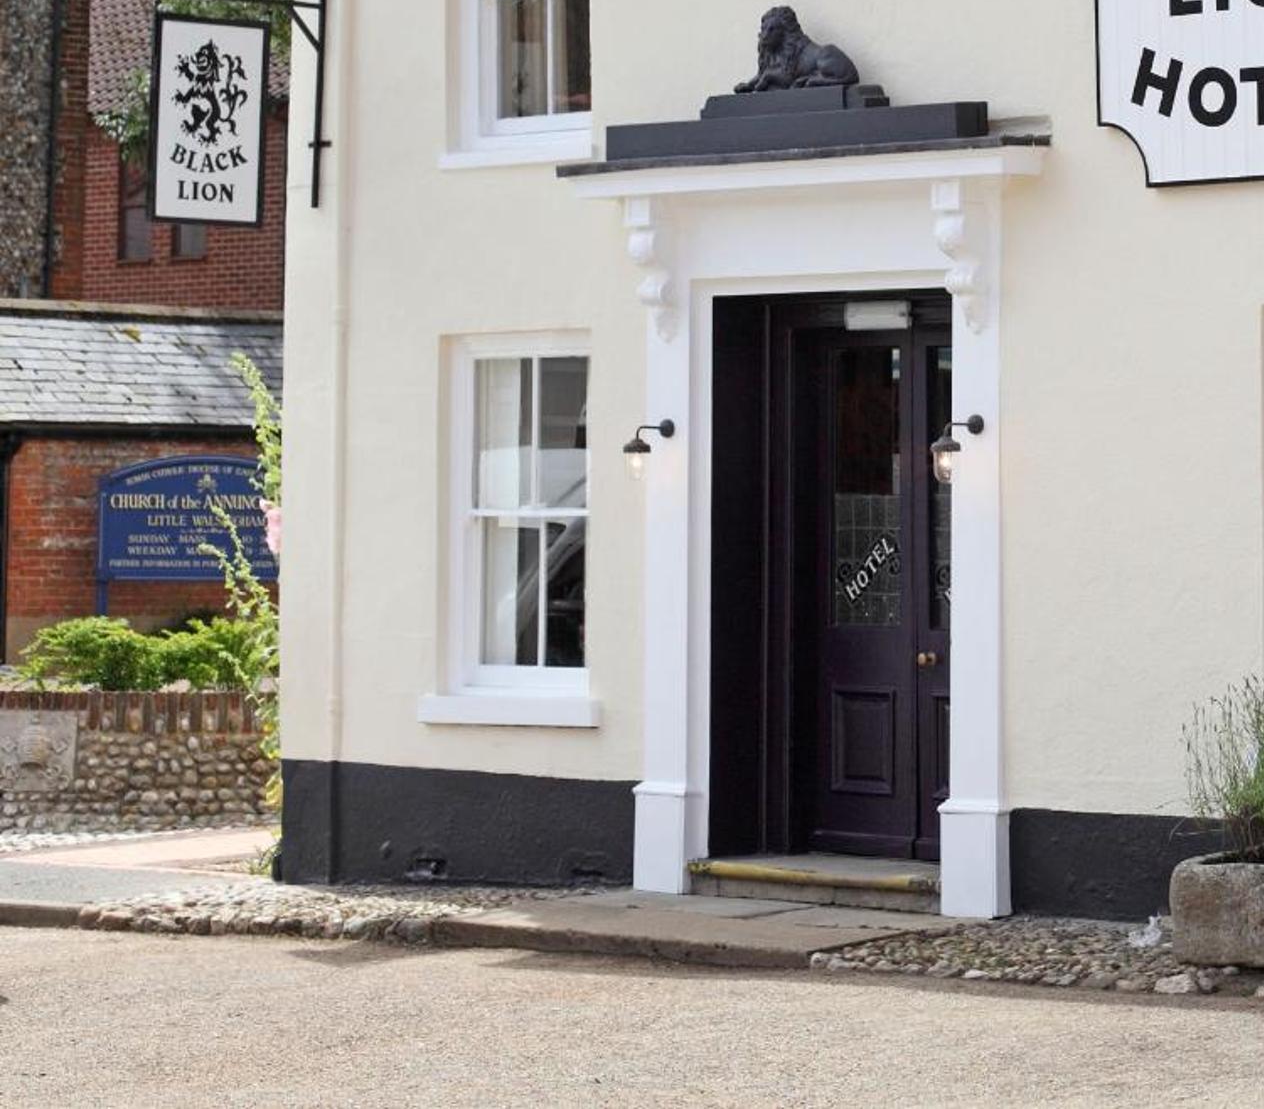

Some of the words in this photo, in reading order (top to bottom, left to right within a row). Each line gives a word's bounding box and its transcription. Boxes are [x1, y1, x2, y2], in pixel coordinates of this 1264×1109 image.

[170, 143, 248, 173] BLACK
[178, 180, 235, 203] LION
[110, 494, 165, 509] CHURCH
[166, 494, 177, 509] of
[180, 494, 201, 509] the
[203, 493, 261, 509] ANNUNC
[147, 515, 187, 527] LITTLE
[845, 538, 895, 600] HOTEL
